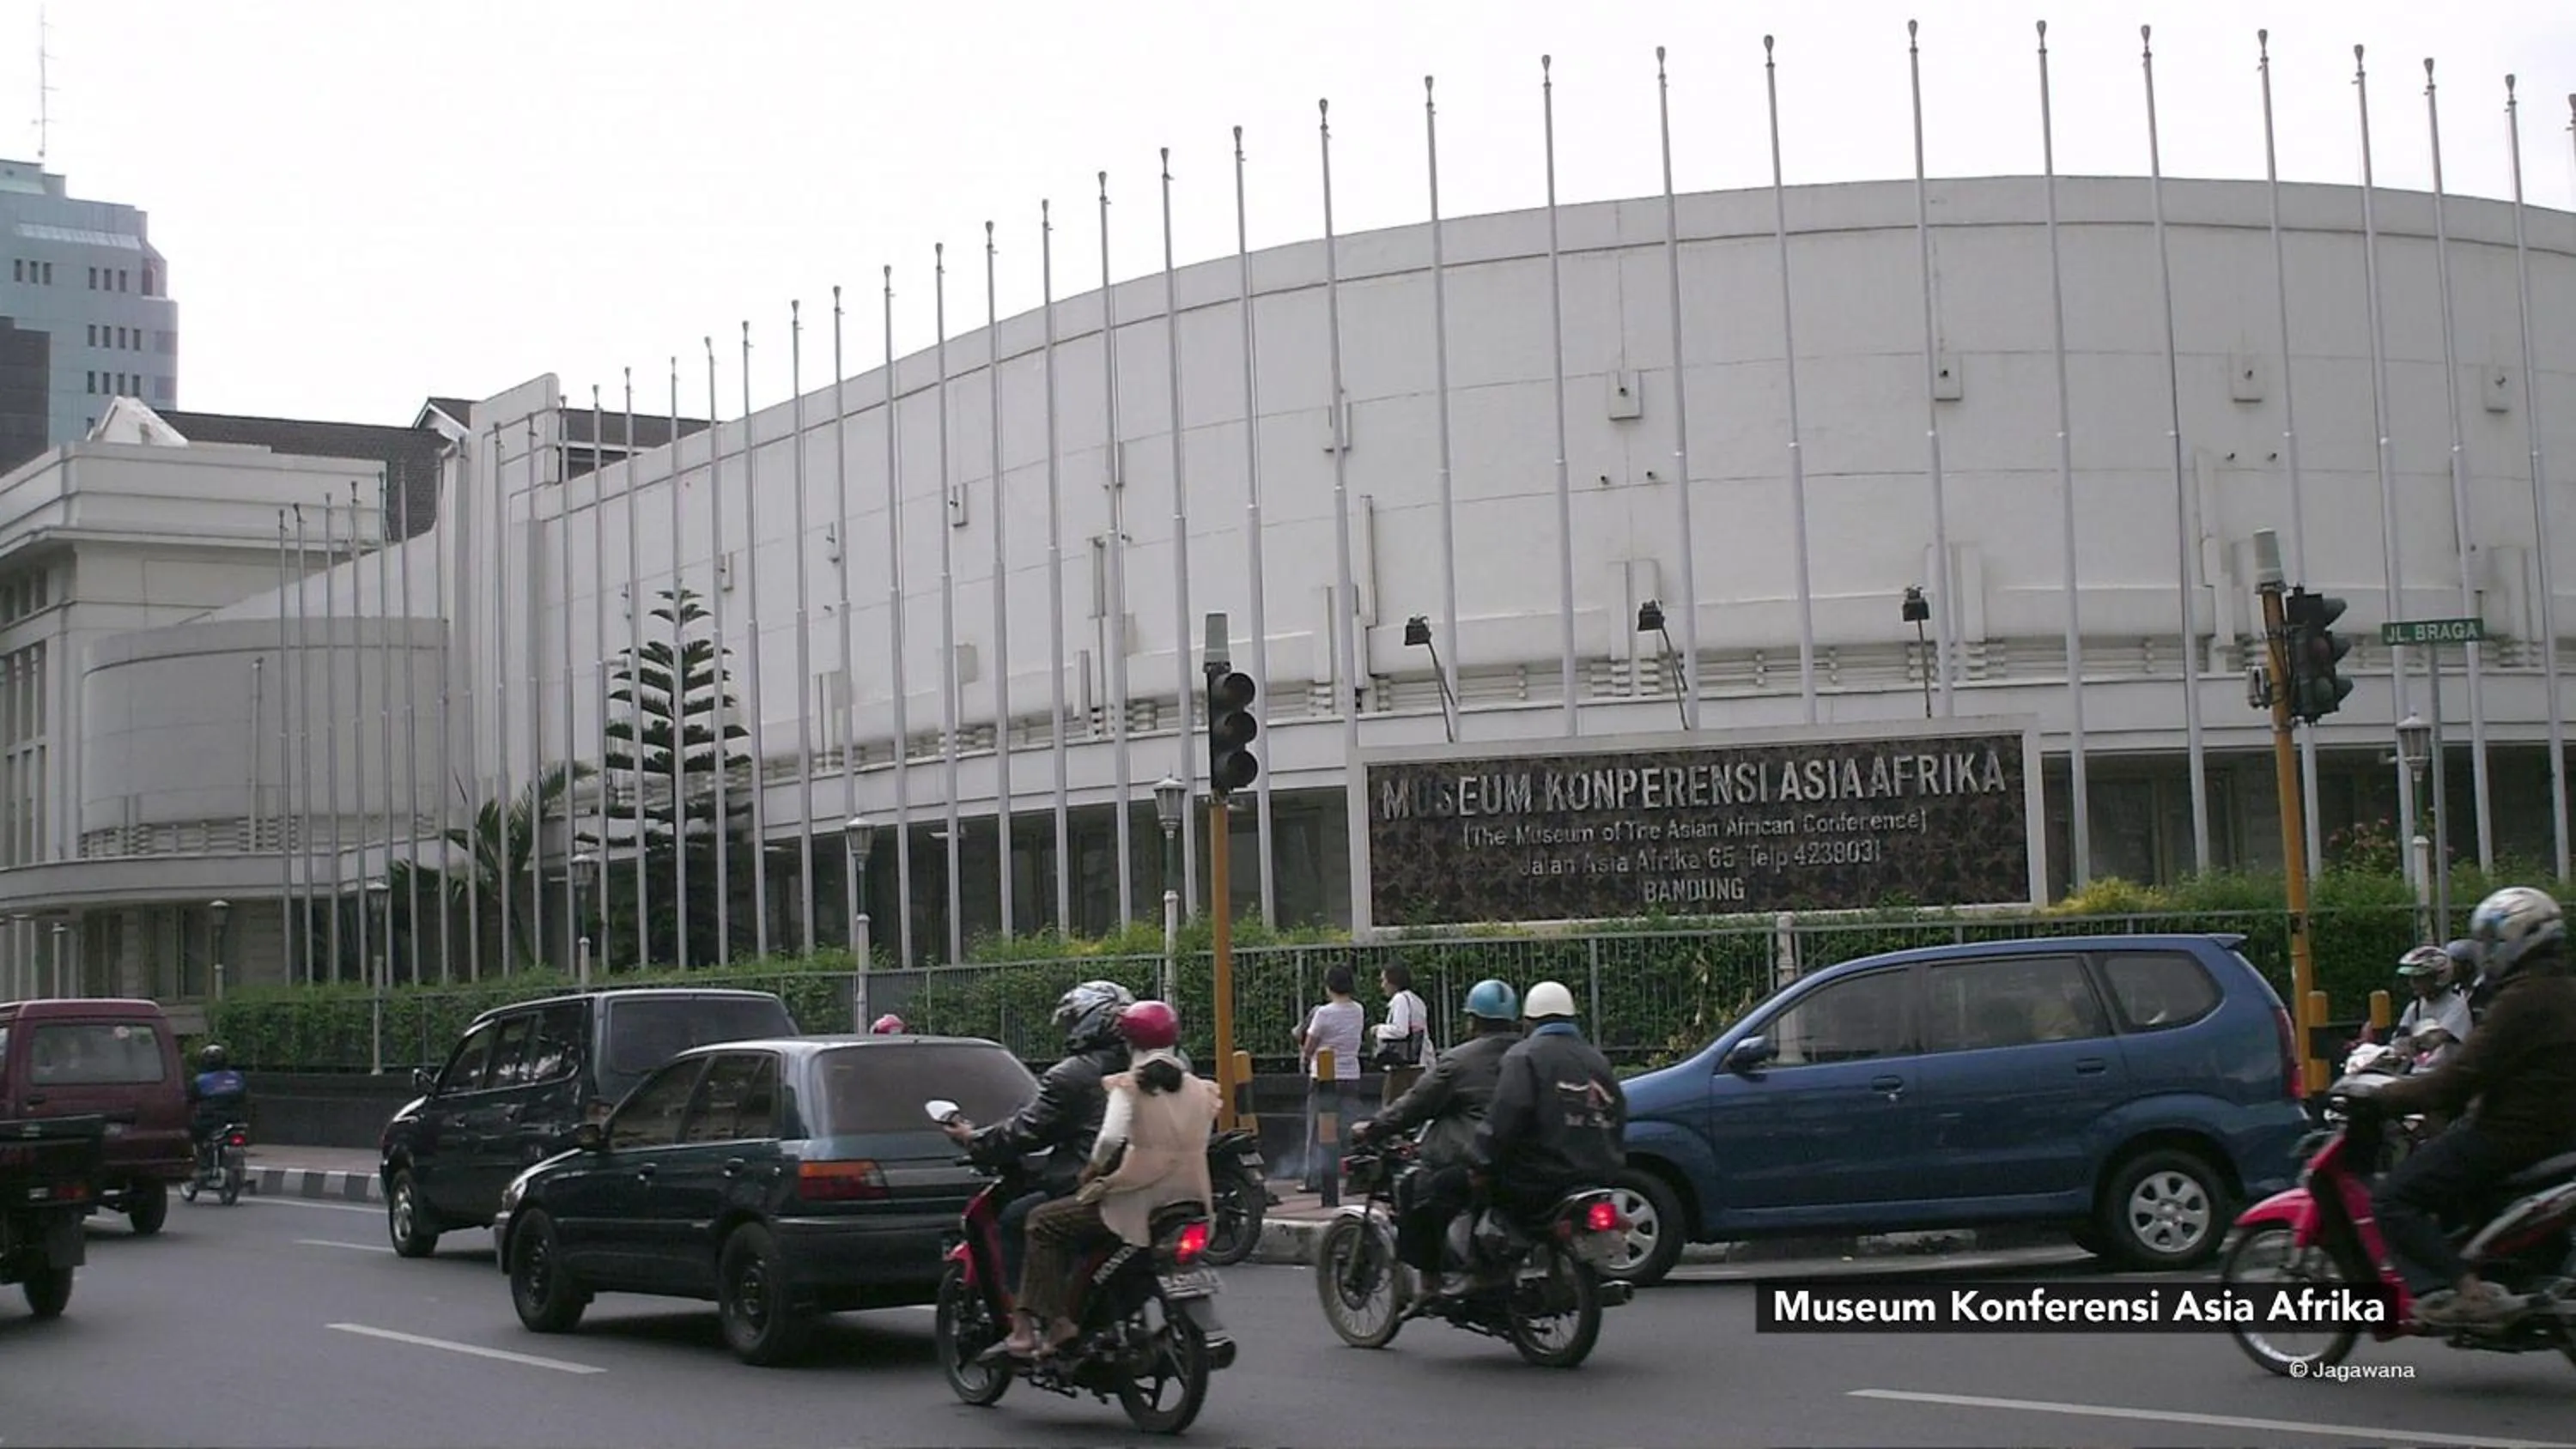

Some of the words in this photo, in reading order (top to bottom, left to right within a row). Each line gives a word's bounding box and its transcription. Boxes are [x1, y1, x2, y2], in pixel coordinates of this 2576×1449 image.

[2415, 621, 2479, 641] BRAGA
[1382, 774, 1533, 820] MUSEUM
[1545, 761, 1768, 812] KONPERENSI
[1778, 758, 1863, 803] ASIA
[1868, 749, 2007, 798] AFRIKA
[1515, 825, 1595, 846] Museum
[1602, 821, 1621, 841] of
[1624, 820, 1662, 840] The
[1668, 818, 1718, 840] Asian
[1726, 816, 1795, 838] African
[1520, 854, 1576, 876] Jalan
[1582, 852, 1630, 874] Asia
[1635, 846, 1702, 872] Afrika
[1708, 845, 1735, 870] 65
[1746, 843, 1789, 875] Telp
[1794, 839, 1881, 866] 4238031
[1644, 876, 1747, 903] BANDUNG
[1092, 1245, 1138, 1285] HONDA
